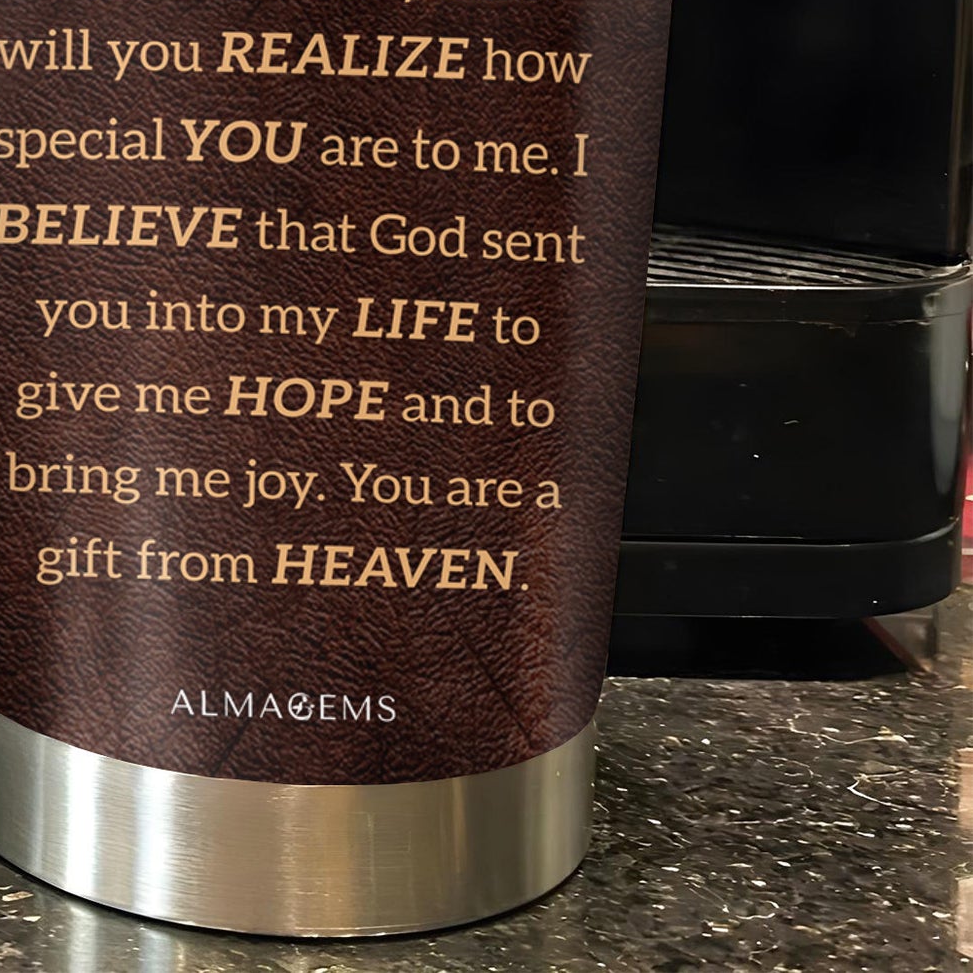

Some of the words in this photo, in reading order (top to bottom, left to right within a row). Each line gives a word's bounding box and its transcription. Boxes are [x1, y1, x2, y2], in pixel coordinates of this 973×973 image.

[106, 40, 203, 81] you
[216, 31, 470, 79] REALIZE
[482, 37, 592, 84] how
[180, 118, 308, 164] YOU
[320, 135, 399, 168] are
[412, 129, 460, 170] to
[473, 141, 558, 175] me.
[573, 133, 589, 176] I
[255, 208, 356, 253] that
[370, 213, 468, 258] God
[482, 225, 586, 264] sent
[35, 299, 132, 337] you
[145, 289, 246, 333] into
[259, 304, 339, 345] my
[352, 297, 480, 342] LIFE
[492, 306, 540, 345] to
[16, 371, 121, 420] give
[134, 383, 211, 415] me
[223, 375, 389, 421] HOPE
[401, 384, 494, 425] and
[507, 390, 555, 428] to
[5, 451, 142, 505] bring
[155, 467, 231, 498] me
[242, 458, 325, 510] joy.
[339, 462, 434, 505] You
[446, 477, 523, 508] are
[535, 480, 562, 509] a
[36, 536, 122, 586] gift
[136, 538, 258, 584] from
[271, 543, 529, 591] HEAVEN.
[170, 689, 396, 722] ALMAGEMS
